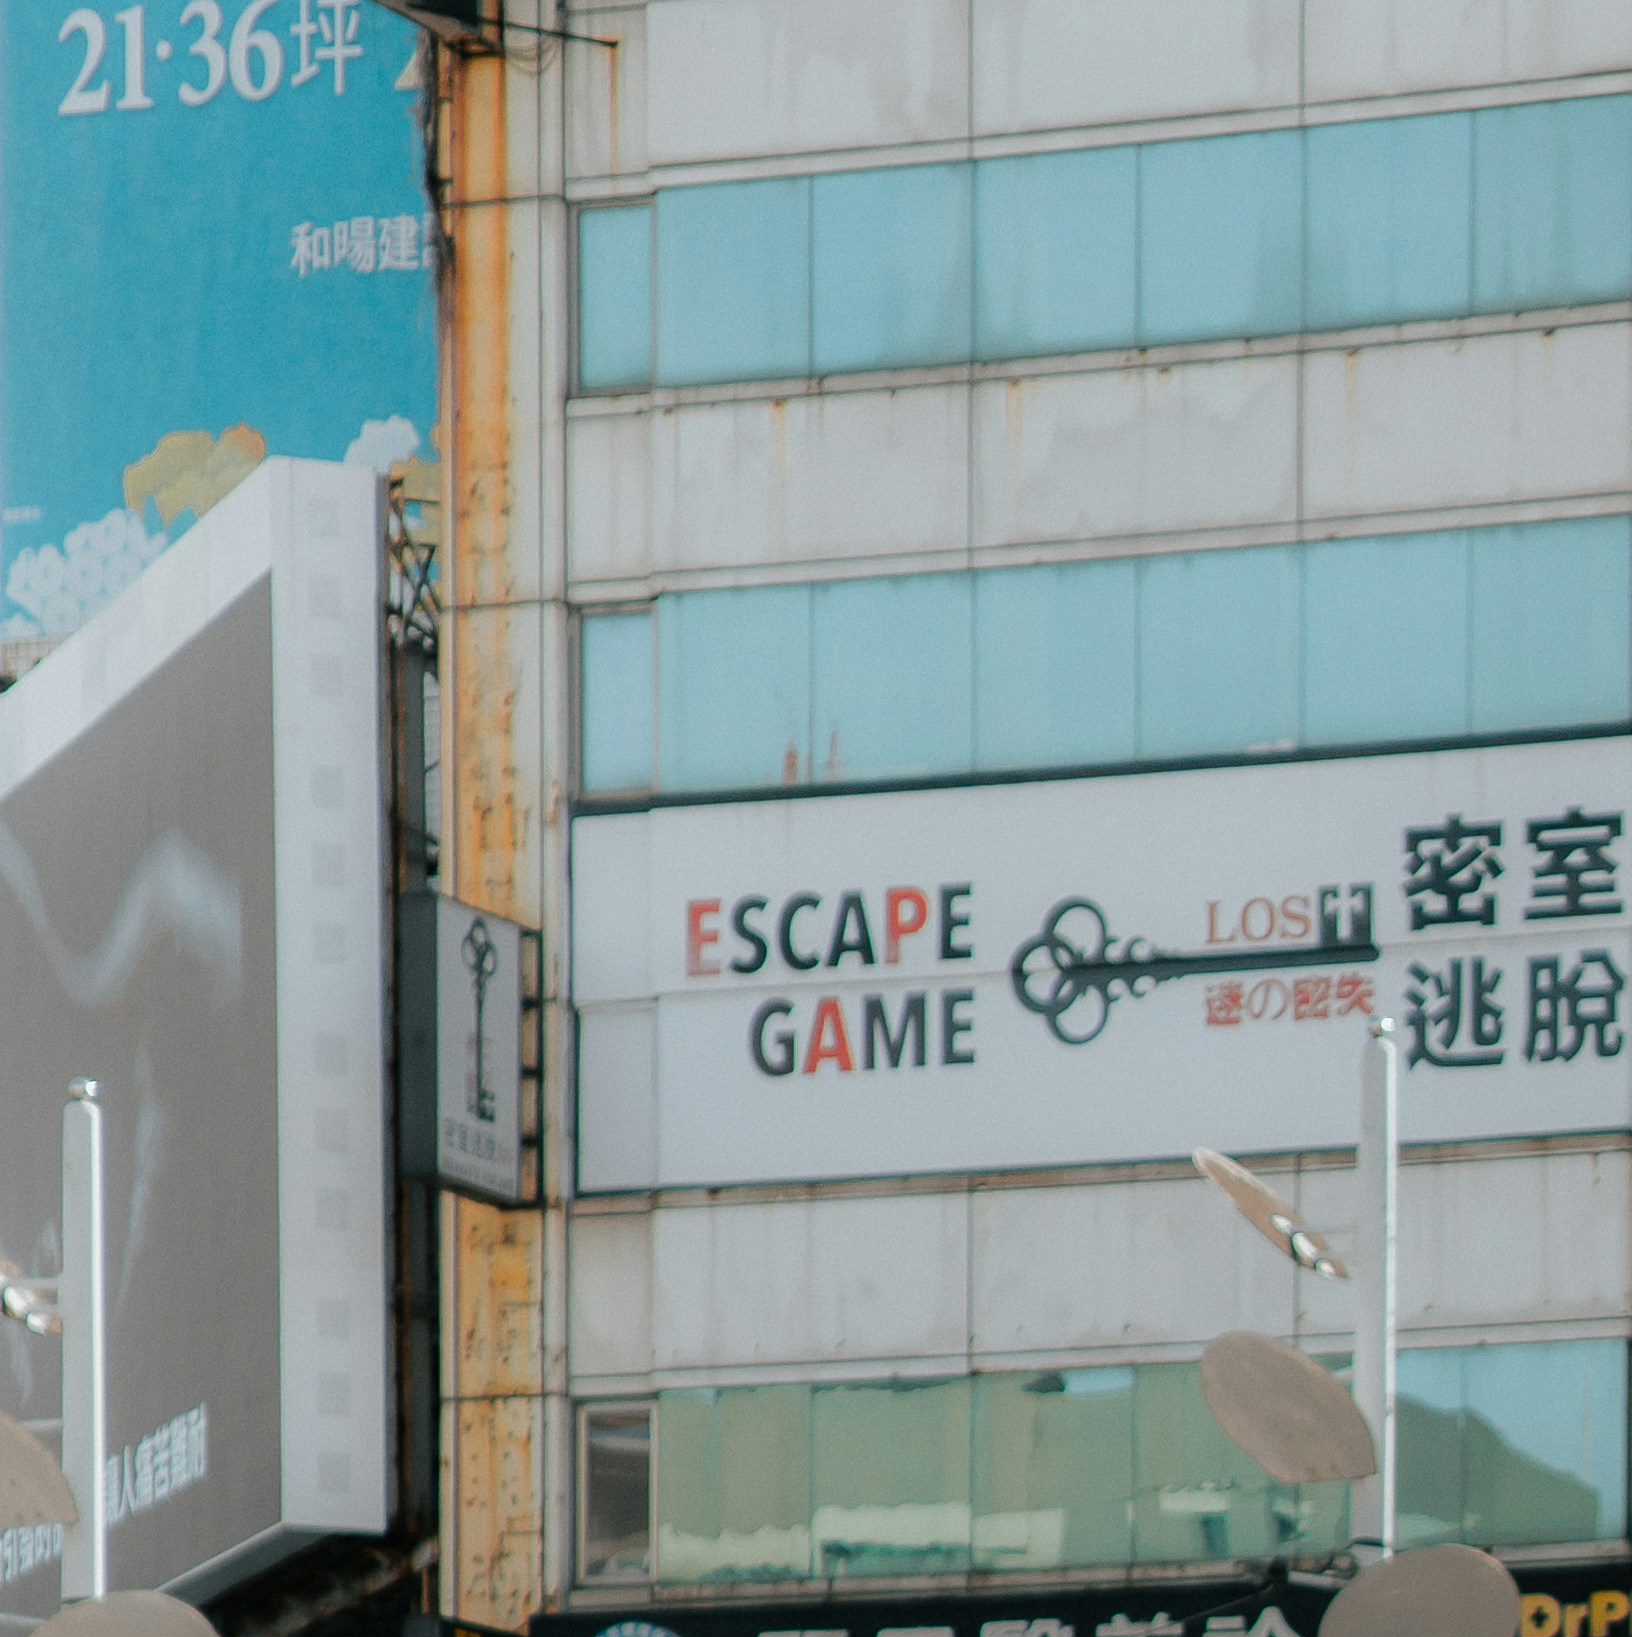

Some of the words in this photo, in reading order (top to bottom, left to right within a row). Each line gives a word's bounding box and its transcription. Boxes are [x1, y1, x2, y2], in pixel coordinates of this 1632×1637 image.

[1405, 807, 1624, 931] 密室
[686, 883, 972, 976] ESCAPE
[751, 989, 974, 1076] GAME
[1405, 949, 1625, 1070] 逃脫
